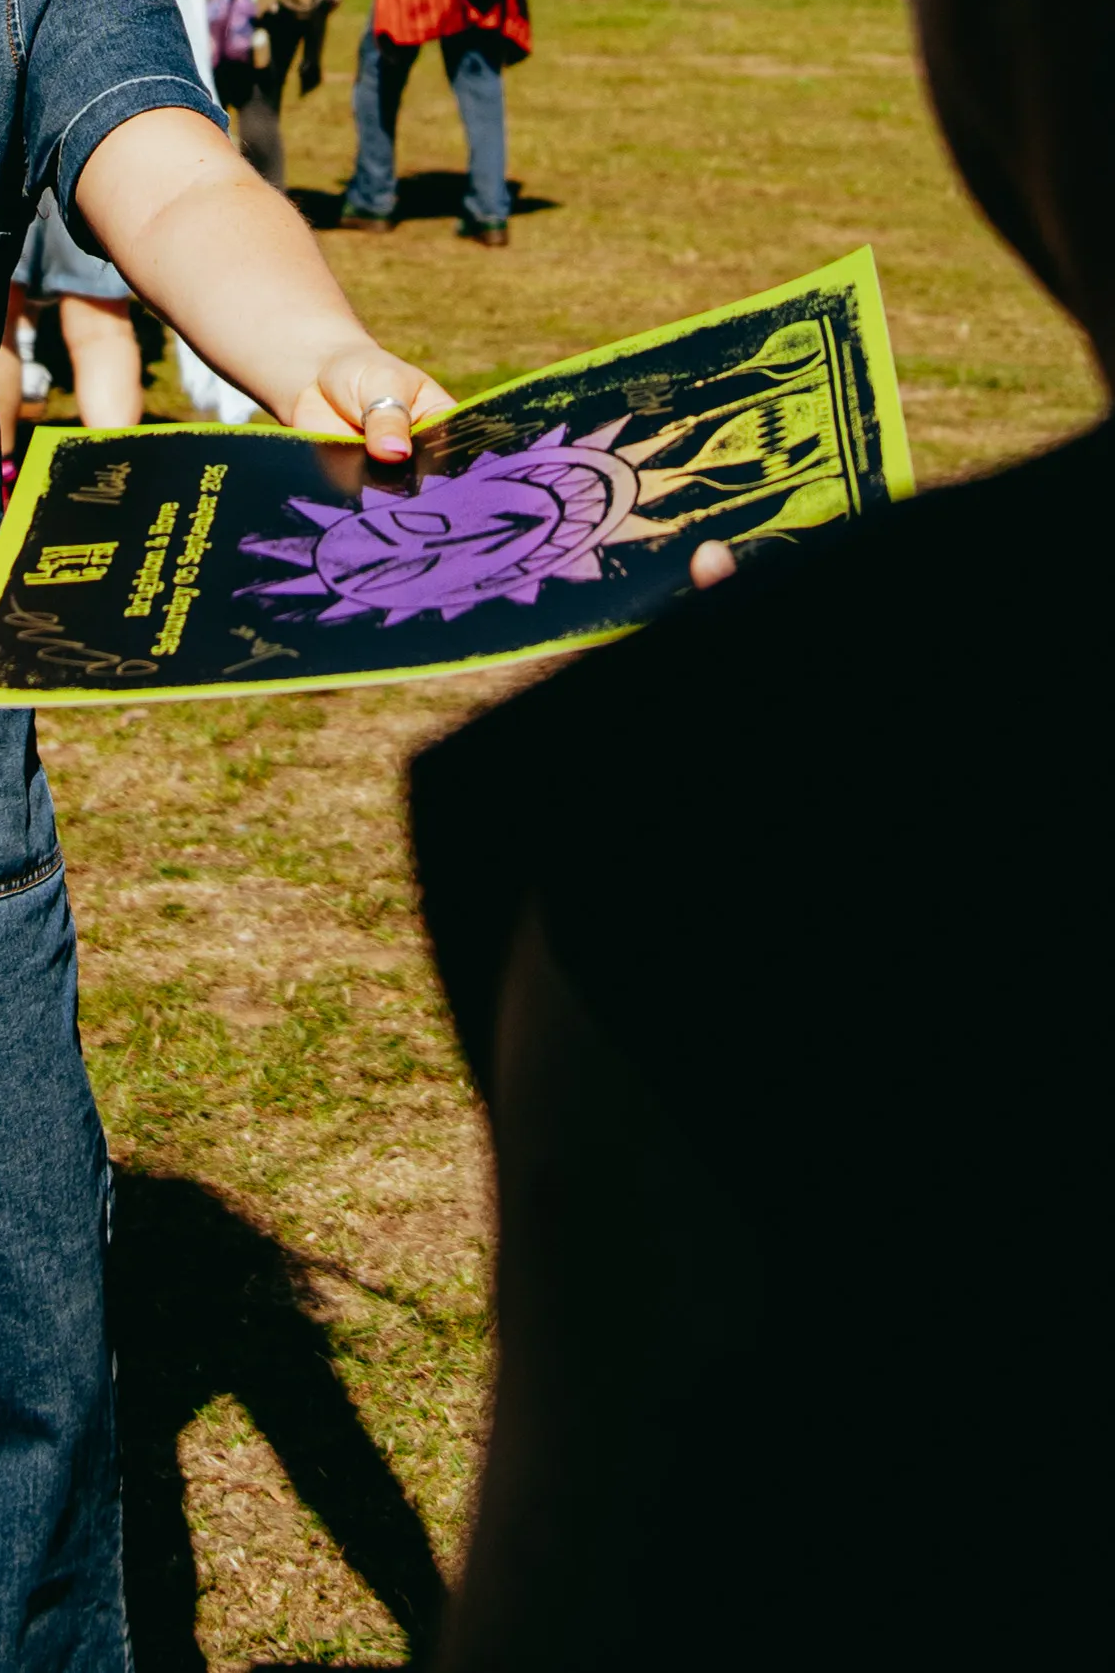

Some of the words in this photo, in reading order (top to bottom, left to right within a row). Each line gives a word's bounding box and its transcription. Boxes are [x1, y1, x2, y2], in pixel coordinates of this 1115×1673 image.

[123, 549, 166, 617] Brighton
[148, 501, 180, 535] Hove
[150, 586, 201, 657] Saturday
[176, 493, 218, 566] September
